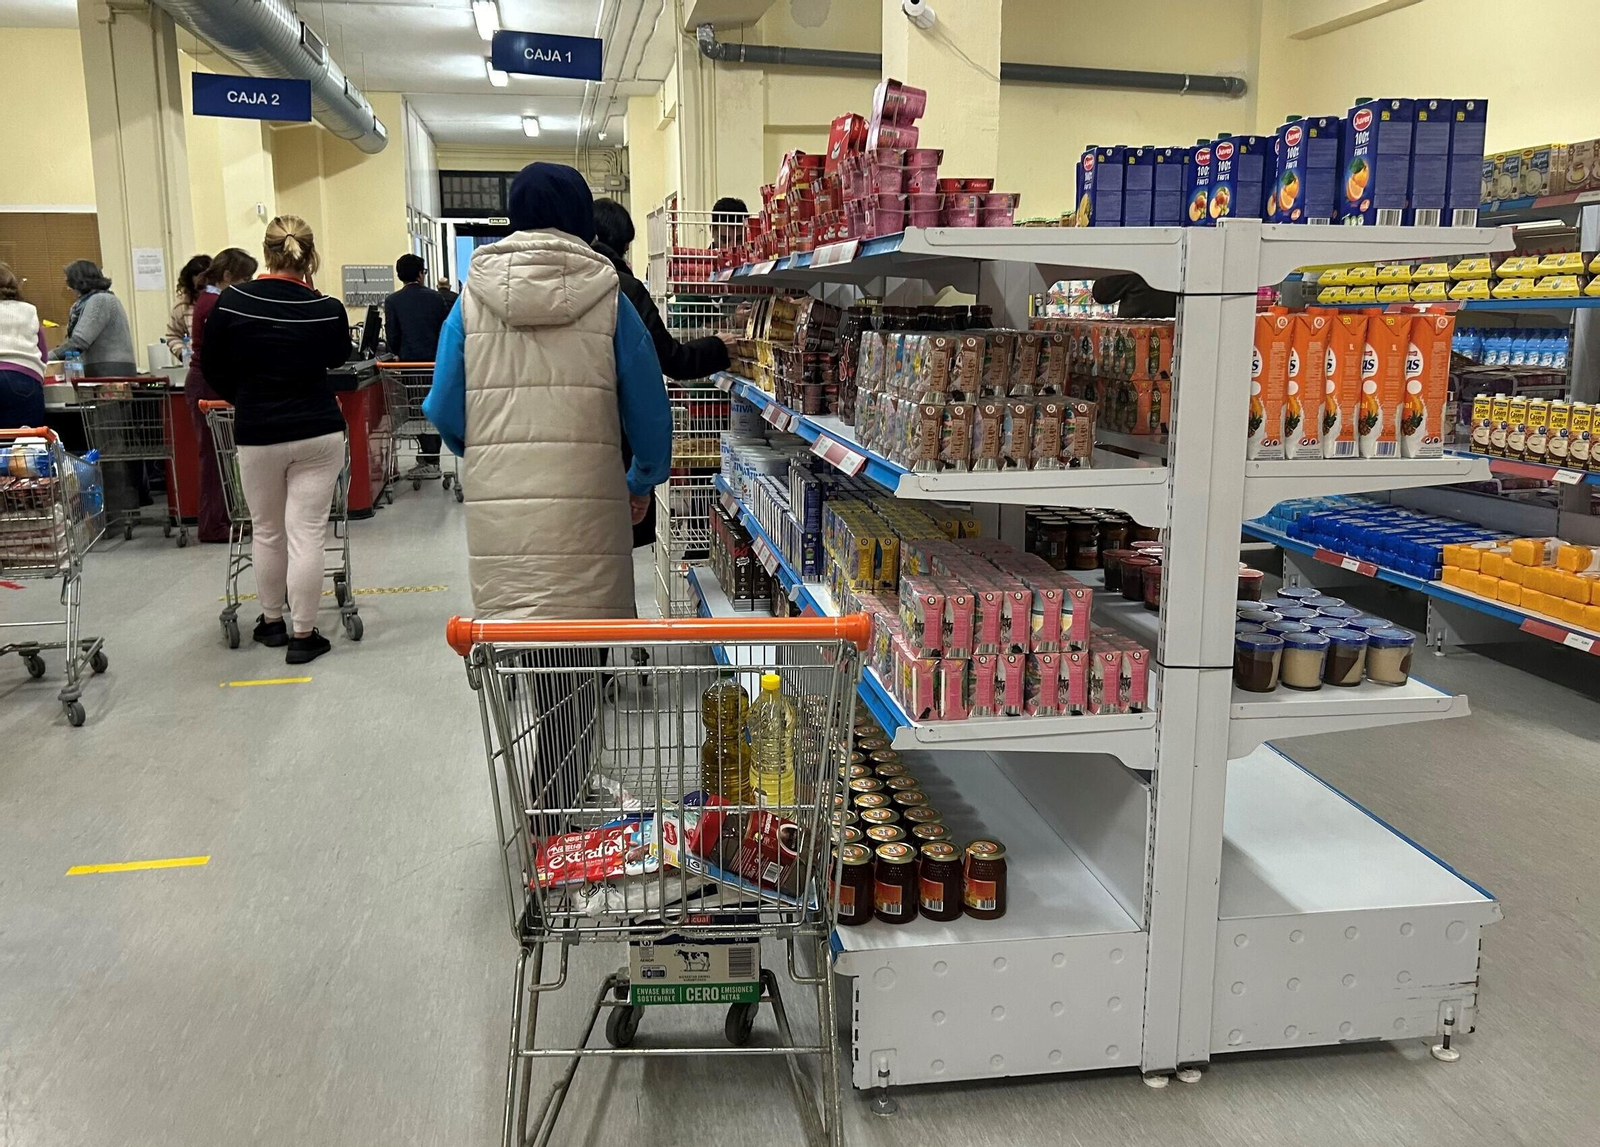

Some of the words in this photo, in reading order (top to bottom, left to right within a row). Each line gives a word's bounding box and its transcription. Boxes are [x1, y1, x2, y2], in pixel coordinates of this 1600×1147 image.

[523, 48, 562, 63] CAJA
[565, 51, 572, 63] 1
[226, 90, 268, 105] CAJA
[271, 93, 280, 105] 2
[637, 987, 659, 995] ENVASE
[661, 987, 676, 995] BRIK
[721, 985, 753, 993] EMISIONES
[686, 986, 719, 1002] CERO
[721, 993, 740, 1001] NETAS
[637, 995, 676, 1003] SOSTENIBLE
